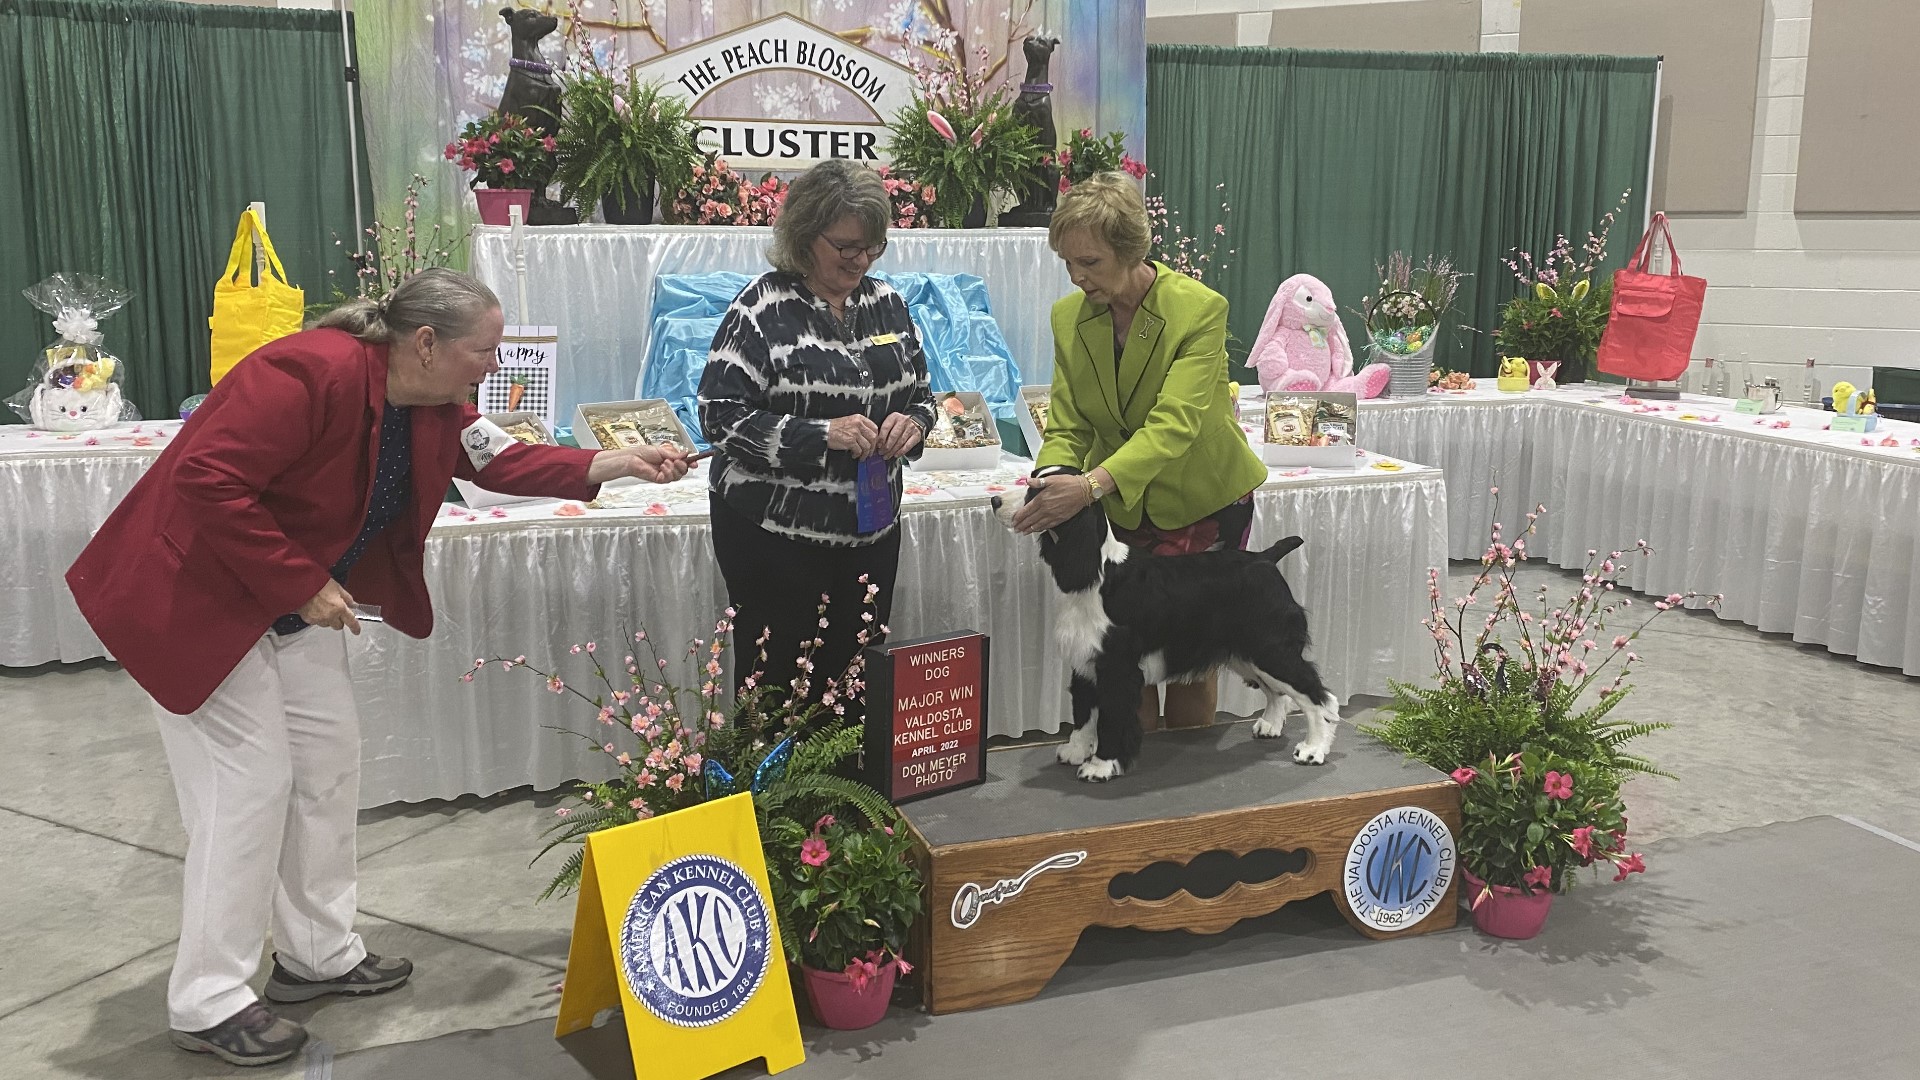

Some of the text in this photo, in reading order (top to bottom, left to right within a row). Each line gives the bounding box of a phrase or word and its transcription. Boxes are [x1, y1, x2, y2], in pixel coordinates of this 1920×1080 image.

[678, 38, 886, 103] THE PEACH BLOSSOM
[692, 126, 879, 161] CLUSTER
[909, 646, 965, 667] WINNERS
[925, 666, 950, 681] DOG
[898, 684, 973, 712] MAJOR WIN
[894, 718, 973, 747] KENNEL CLUB
[904, 706, 964, 729] VALDOSTA
[911, 739, 959, 758] APRIL 2022
[902, 752, 967, 778] DON MEYER
[1398, 810, 1447, 846] KENNEL
[1348, 814, 1394, 887] VALDOSTA
[1350, 885, 1370, 918] THE
[631, 865, 761, 974] AMERICAN KENNEL CLUB
[1378, 911, 1403, 924] 1962
[661, 891, 743, 994] AKC
[666, 969, 754, 1017] FOUNDED 1884
